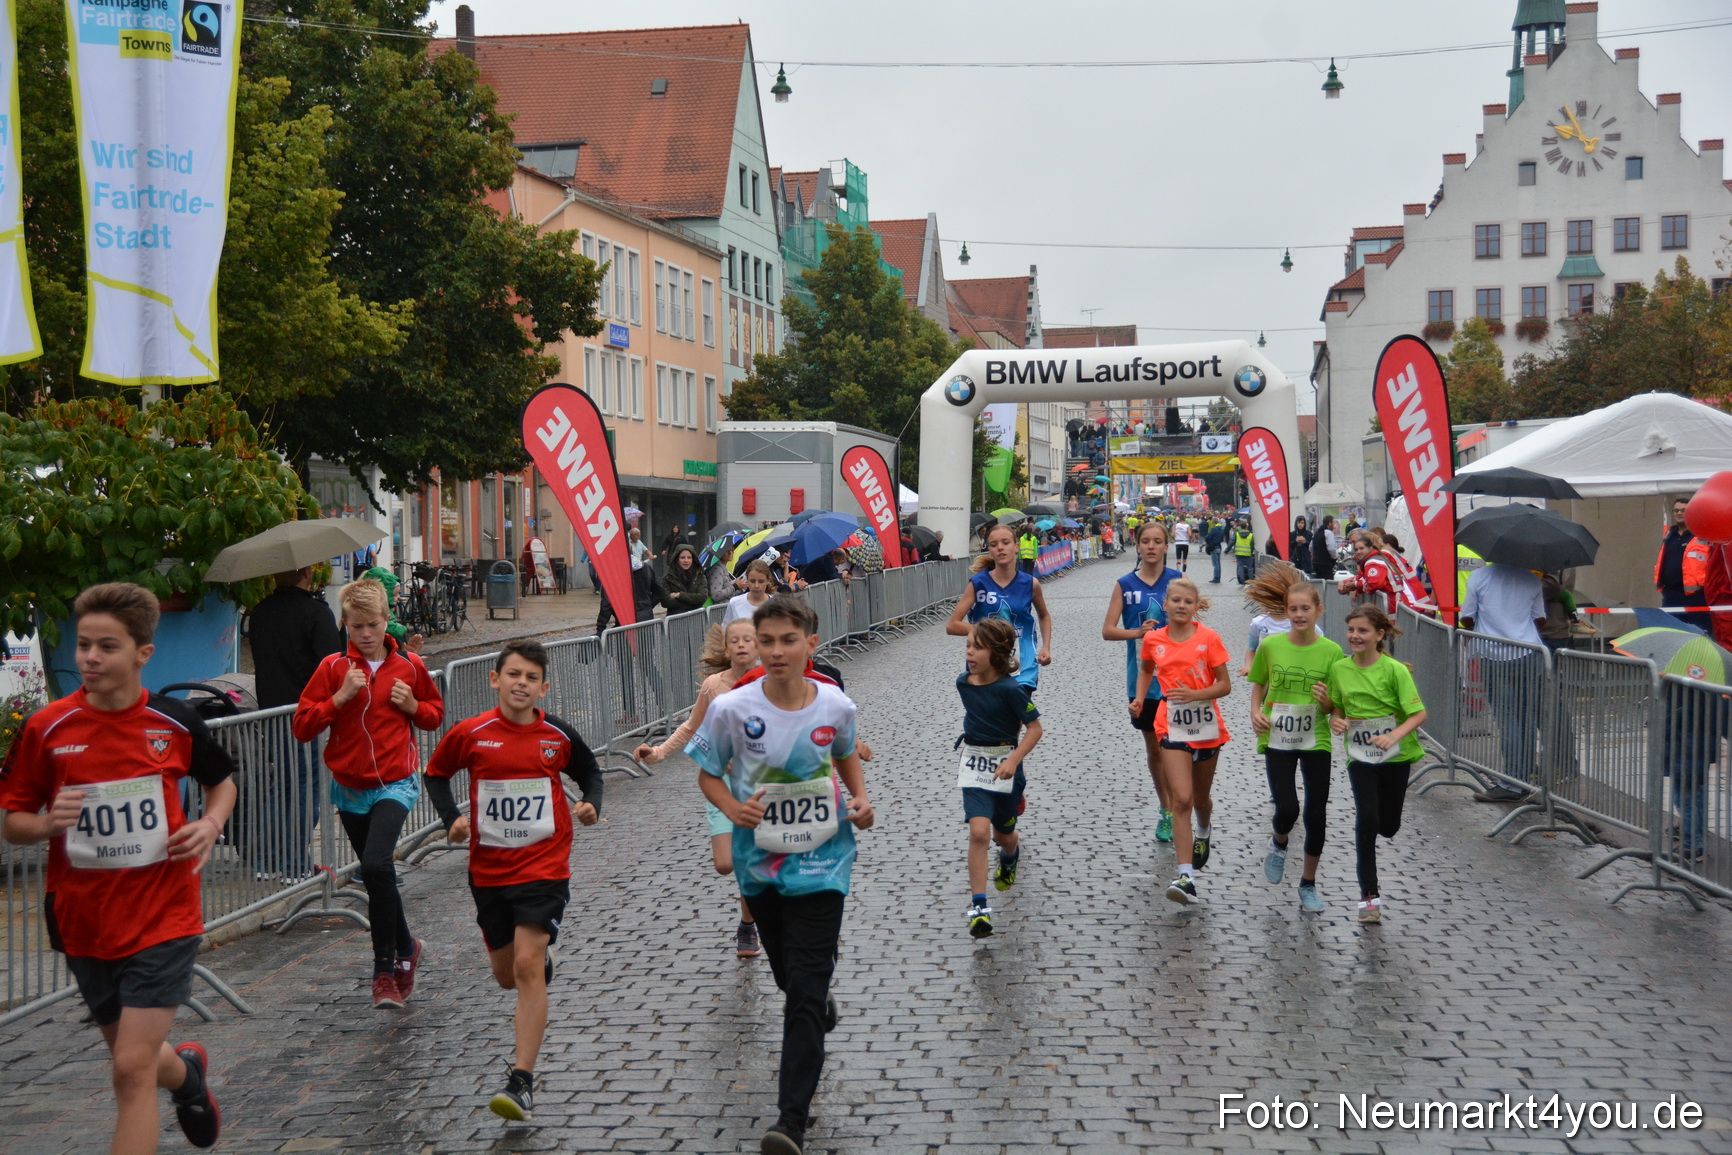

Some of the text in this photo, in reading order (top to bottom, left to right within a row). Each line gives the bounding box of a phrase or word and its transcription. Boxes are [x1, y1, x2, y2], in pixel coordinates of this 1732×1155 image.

[82, 6, 176, 31] Fairtrade
[122, 36, 171, 53] Towns
[183, 42, 219, 55] FAIRTRADE
[93, 140, 193, 175] Wir sind
[94, 222, 171, 250] Stadt
[986, 355, 1222, 386] BMW Laufsport
[1159, 459, 1187, 470] ZIEL
[1123, 590, 1142, 605] 11
[1172, 706, 1213, 725] 4015
[1275, 715, 1312, 733] 4013
[1280, 735, 1303, 744] Victoria
[965, 755, 1008, 773] 405
[974, 775, 996, 785] Jonas
[77, 798, 158, 837] 4018
[486, 795, 546, 822] 4027
[762, 796, 830, 826] 4025
[504, 828, 528, 838] Elias
[782, 831, 812, 843] Frank
[97, 843, 142, 858] Marius
